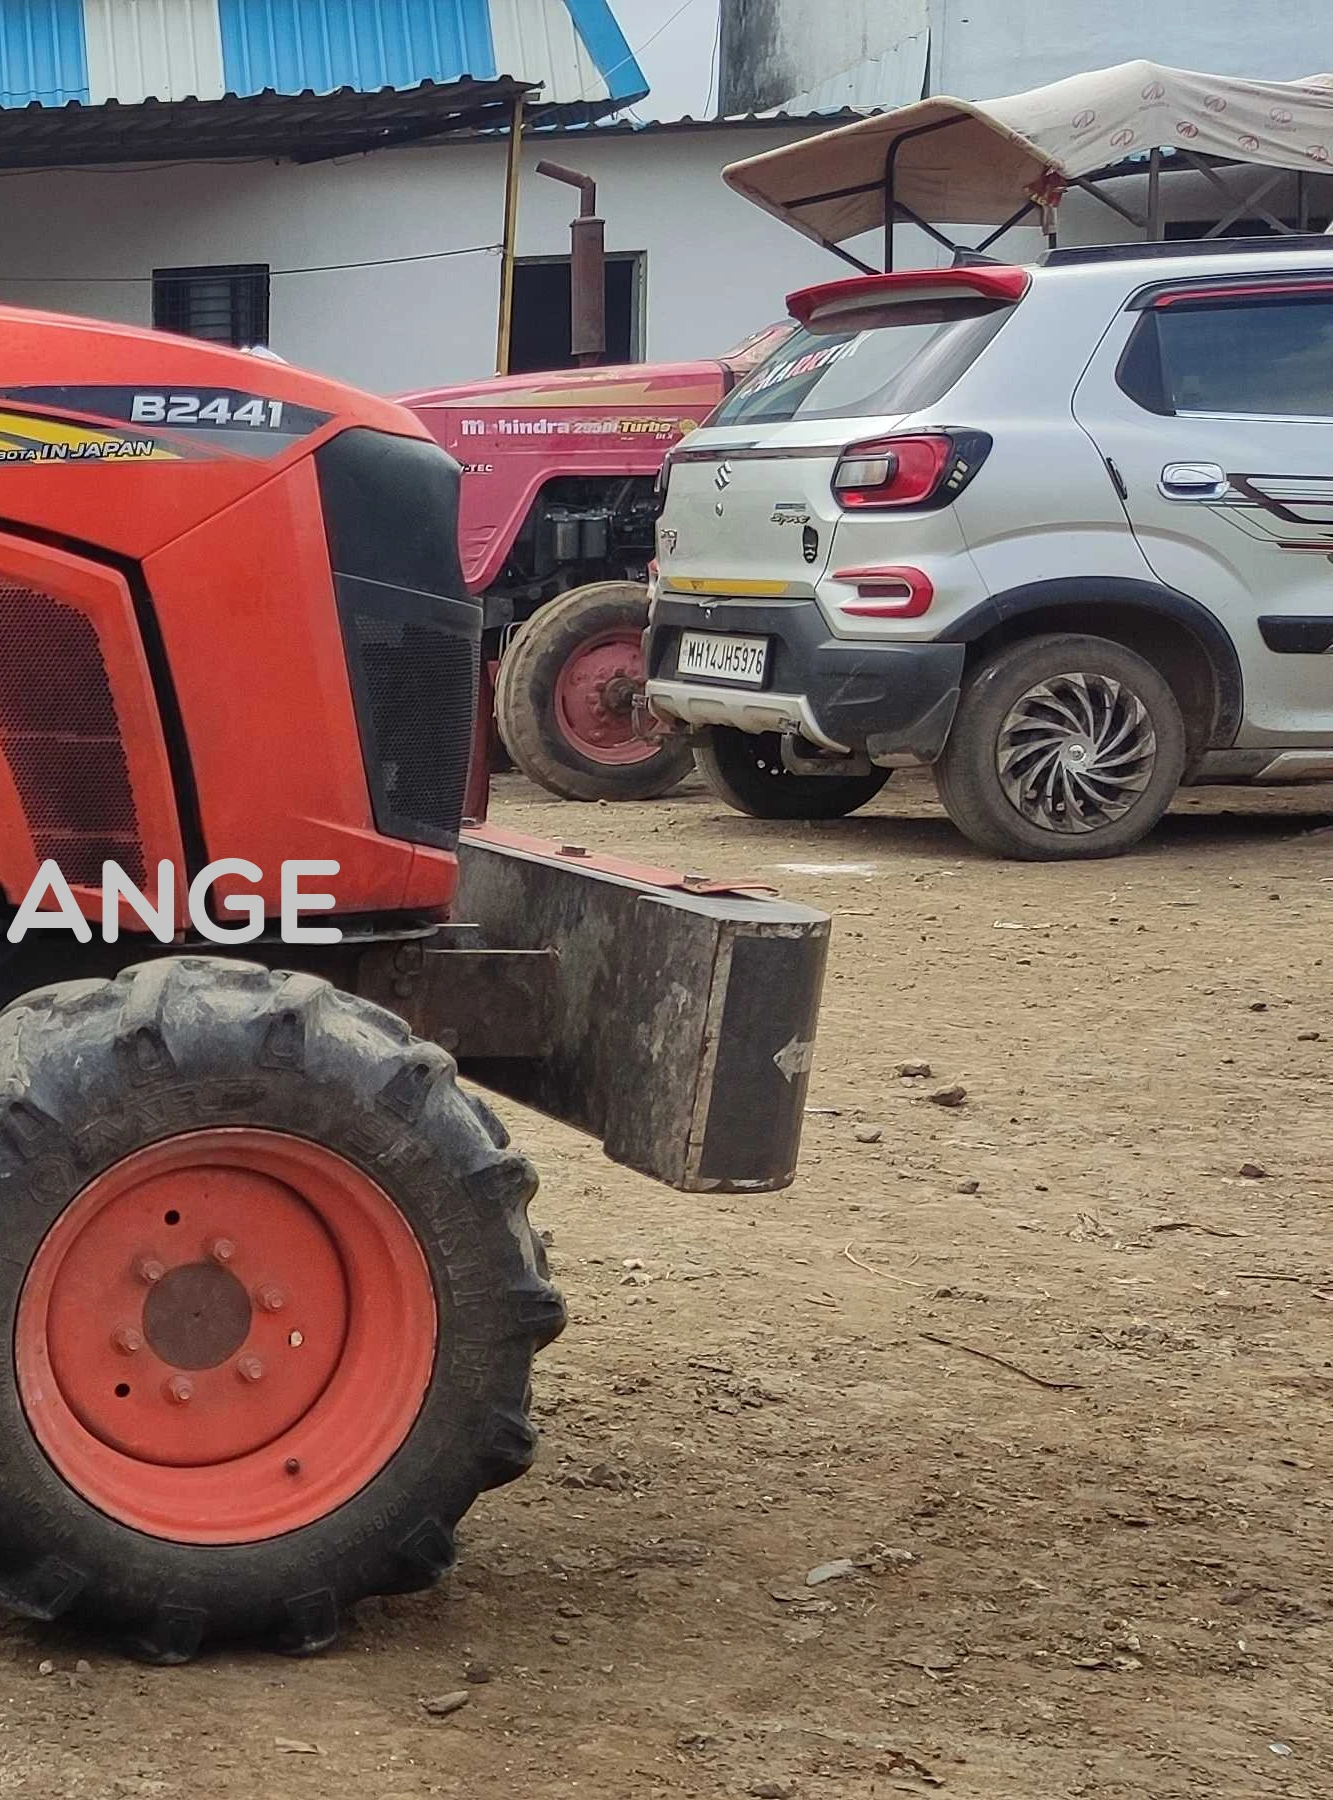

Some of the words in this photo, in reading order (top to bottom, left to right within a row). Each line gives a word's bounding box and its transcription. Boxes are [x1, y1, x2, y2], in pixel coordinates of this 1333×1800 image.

[131, 395, 283, 428] B2441
[41, 444, 67, 459] IN
[70, 441, 153, 458] JAPAN
[686, 640, 764, 675] MH14JH5976
